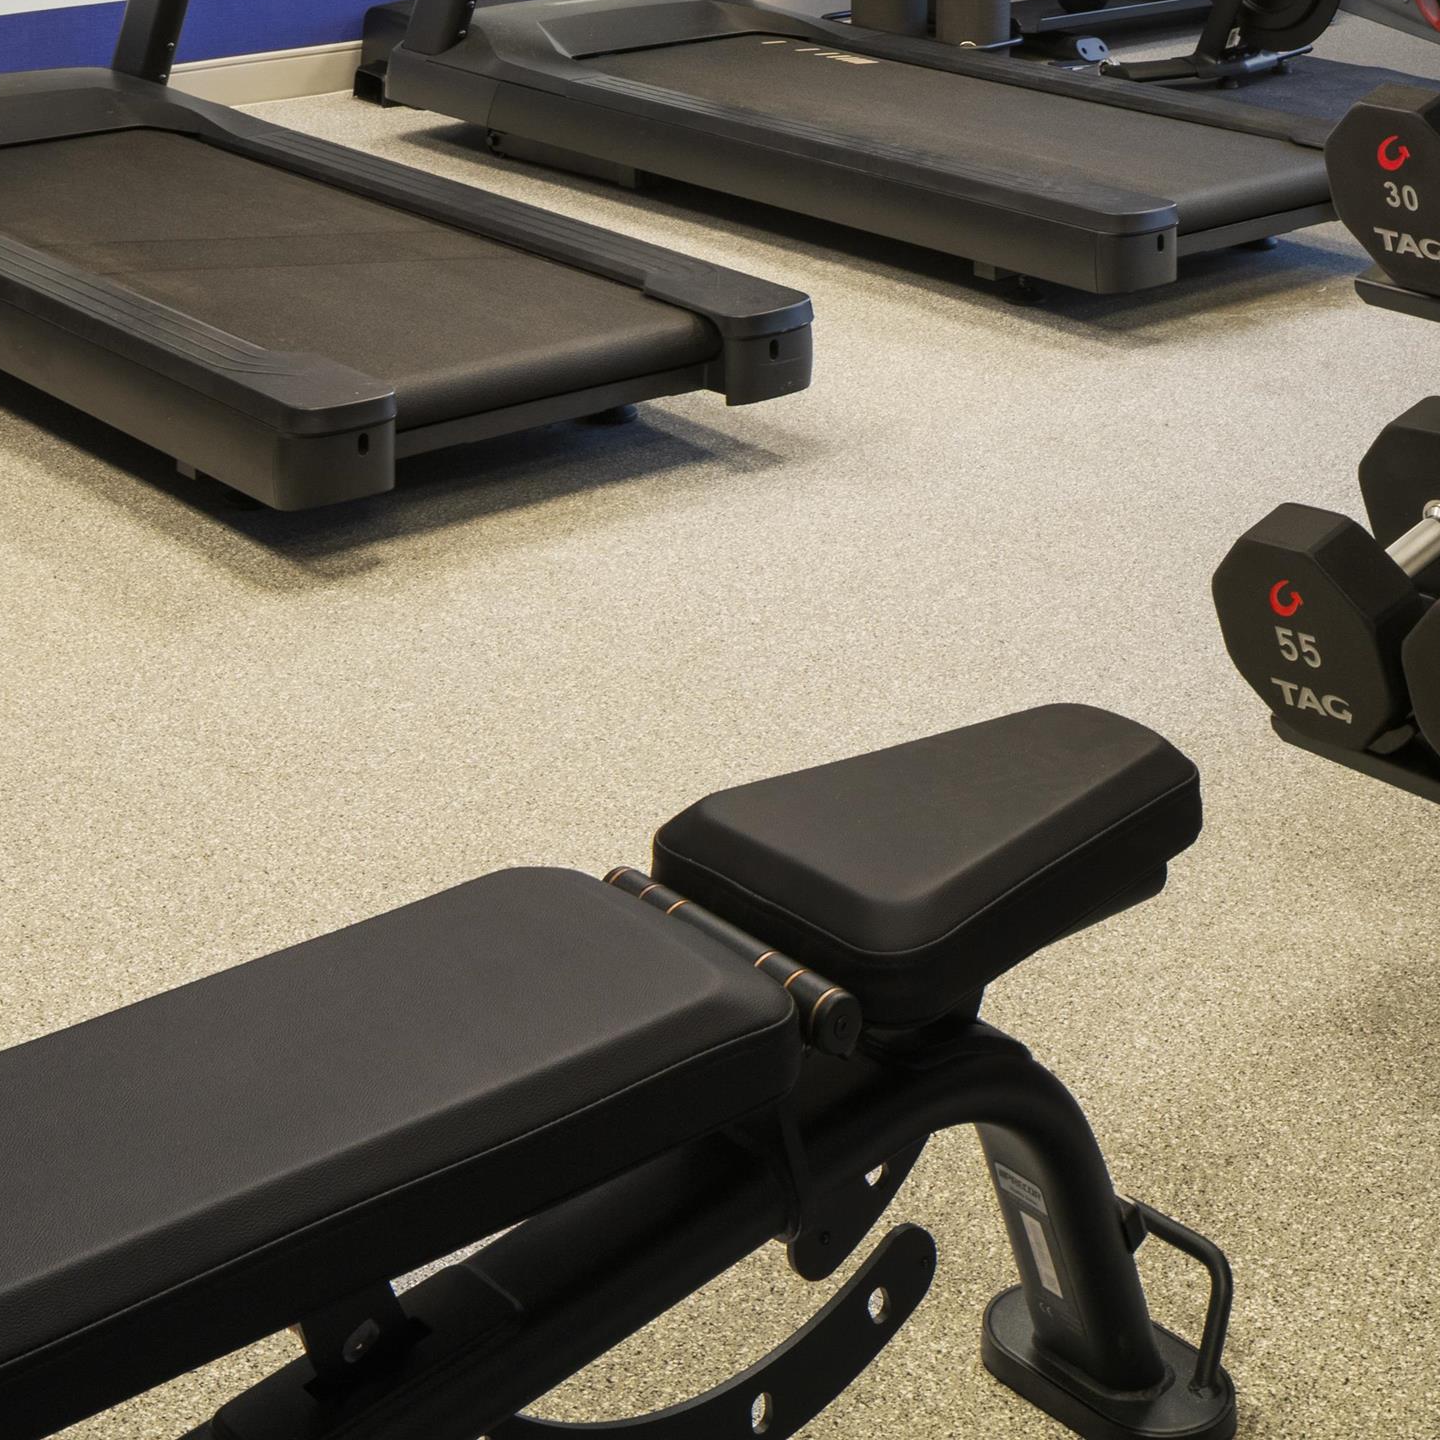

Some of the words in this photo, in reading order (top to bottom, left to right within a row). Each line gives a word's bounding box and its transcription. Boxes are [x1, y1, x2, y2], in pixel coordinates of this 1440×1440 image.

[1384, 182, 1418, 211] 30
[1275, 626, 1321, 668] 55
[1270, 677, 1354, 724] TAG
